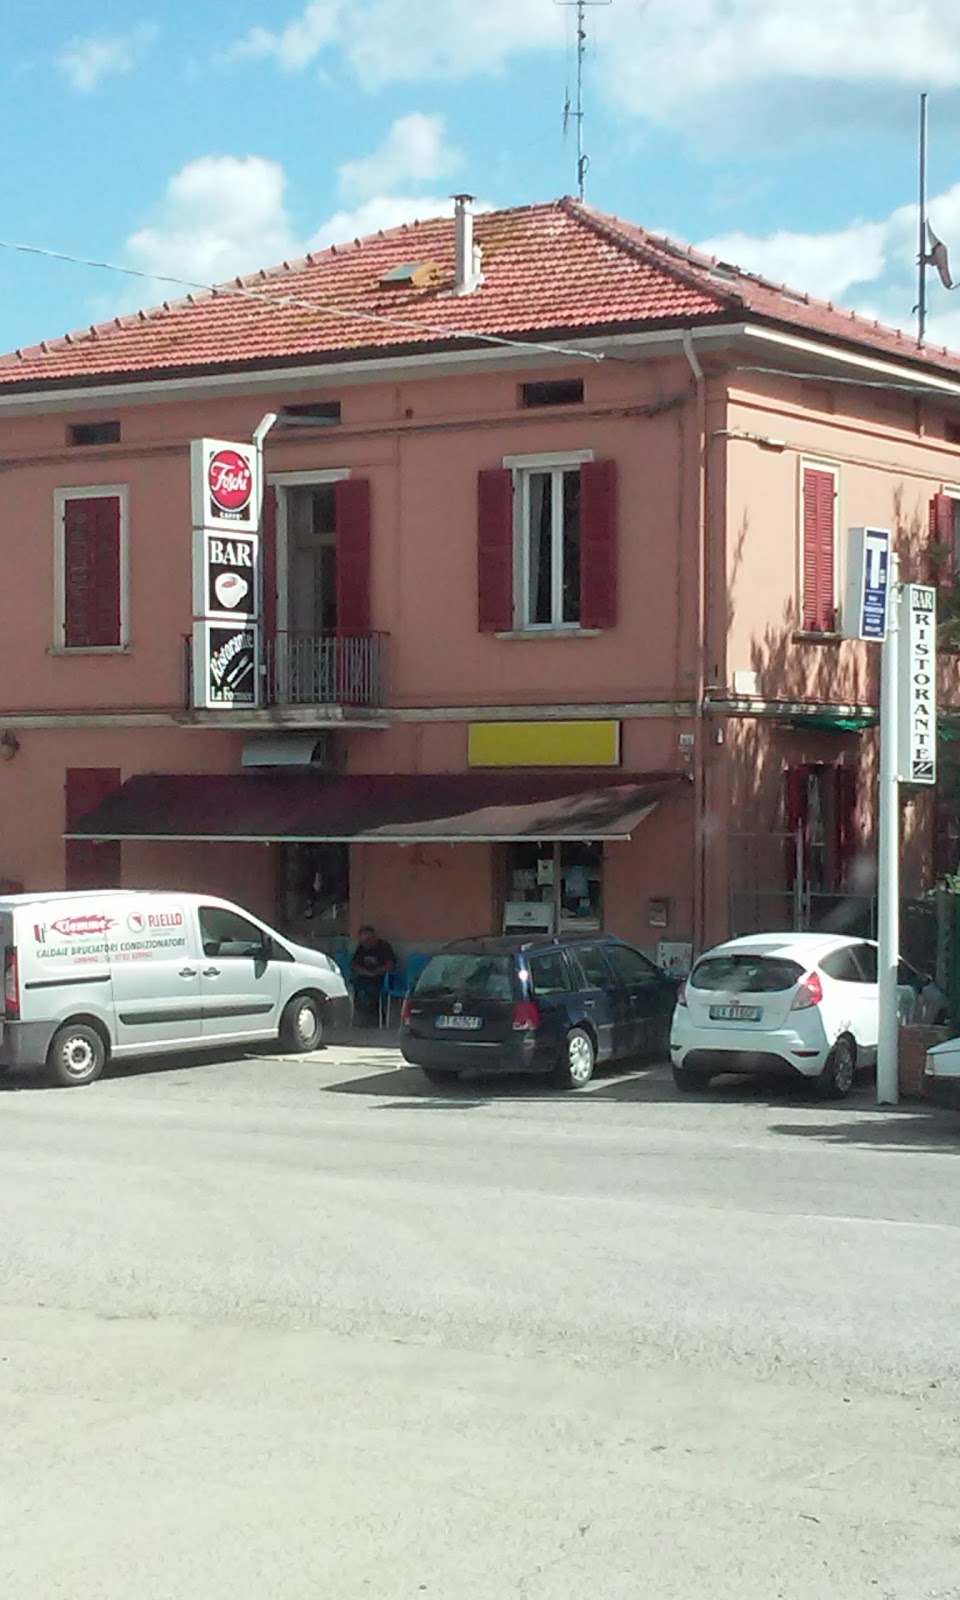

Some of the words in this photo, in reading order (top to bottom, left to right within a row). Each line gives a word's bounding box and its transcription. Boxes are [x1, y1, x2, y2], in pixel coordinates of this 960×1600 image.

[211, 541, 251, 566] BAR
[866, 536, 887, 589] T
[912, 589, 932, 609] BAR
[210, 631, 254, 686] Ristorante
[211, 686, 222, 701] La
[913, 614, 931, 760] RISTORANTE
[148, 913, 182, 927] RIELLO
[36, 945, 68, 958] CALDAIE
[71, 943, 118, 956] BRUCIATORI
[120, 937, 185, 951] CONDIZIONATORI
